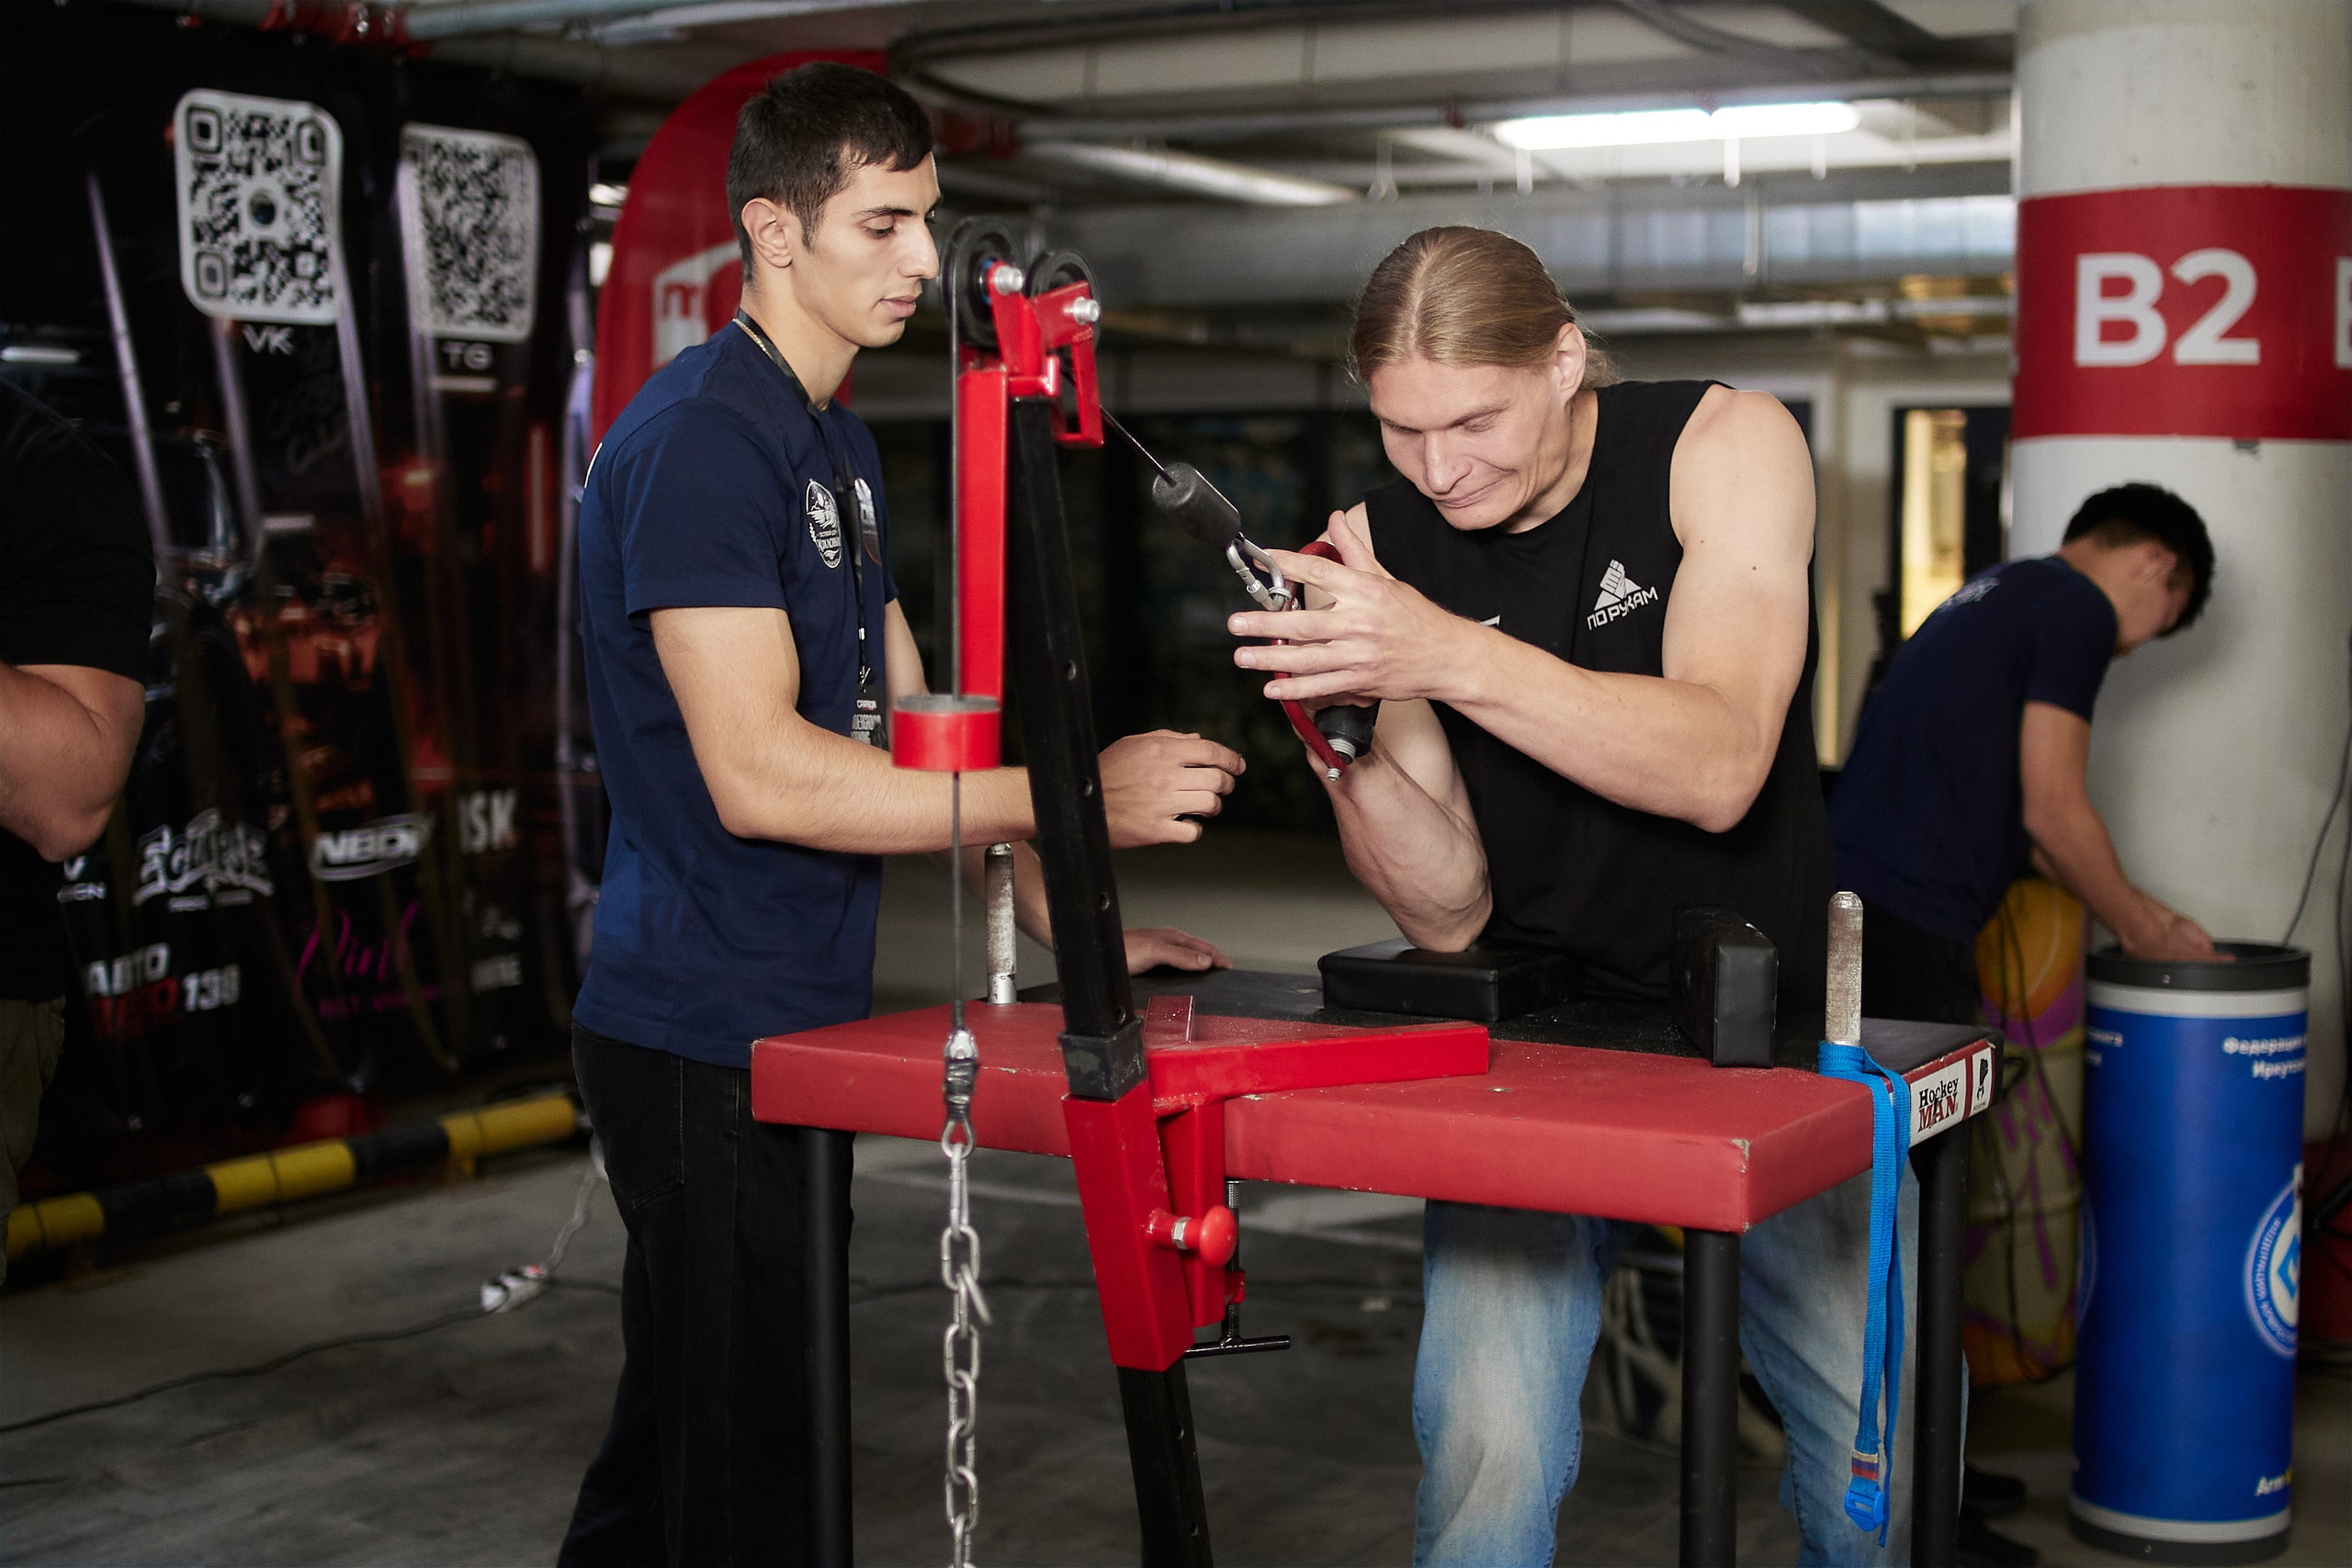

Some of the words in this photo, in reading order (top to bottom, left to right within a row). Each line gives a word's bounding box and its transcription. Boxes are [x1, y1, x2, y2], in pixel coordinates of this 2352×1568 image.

[2075, 248, 2260, 367] B2
[243, 323, 295, 356] VK
[443, 341, 493, 370] TG
[1587, 610, 1608, 631] ПО
[1608, 586, 1658, 622] РУКАМ
[1918, 1077, 1959, 1109] Hockey
[1917, 1091, 1959, 1133] MAN
